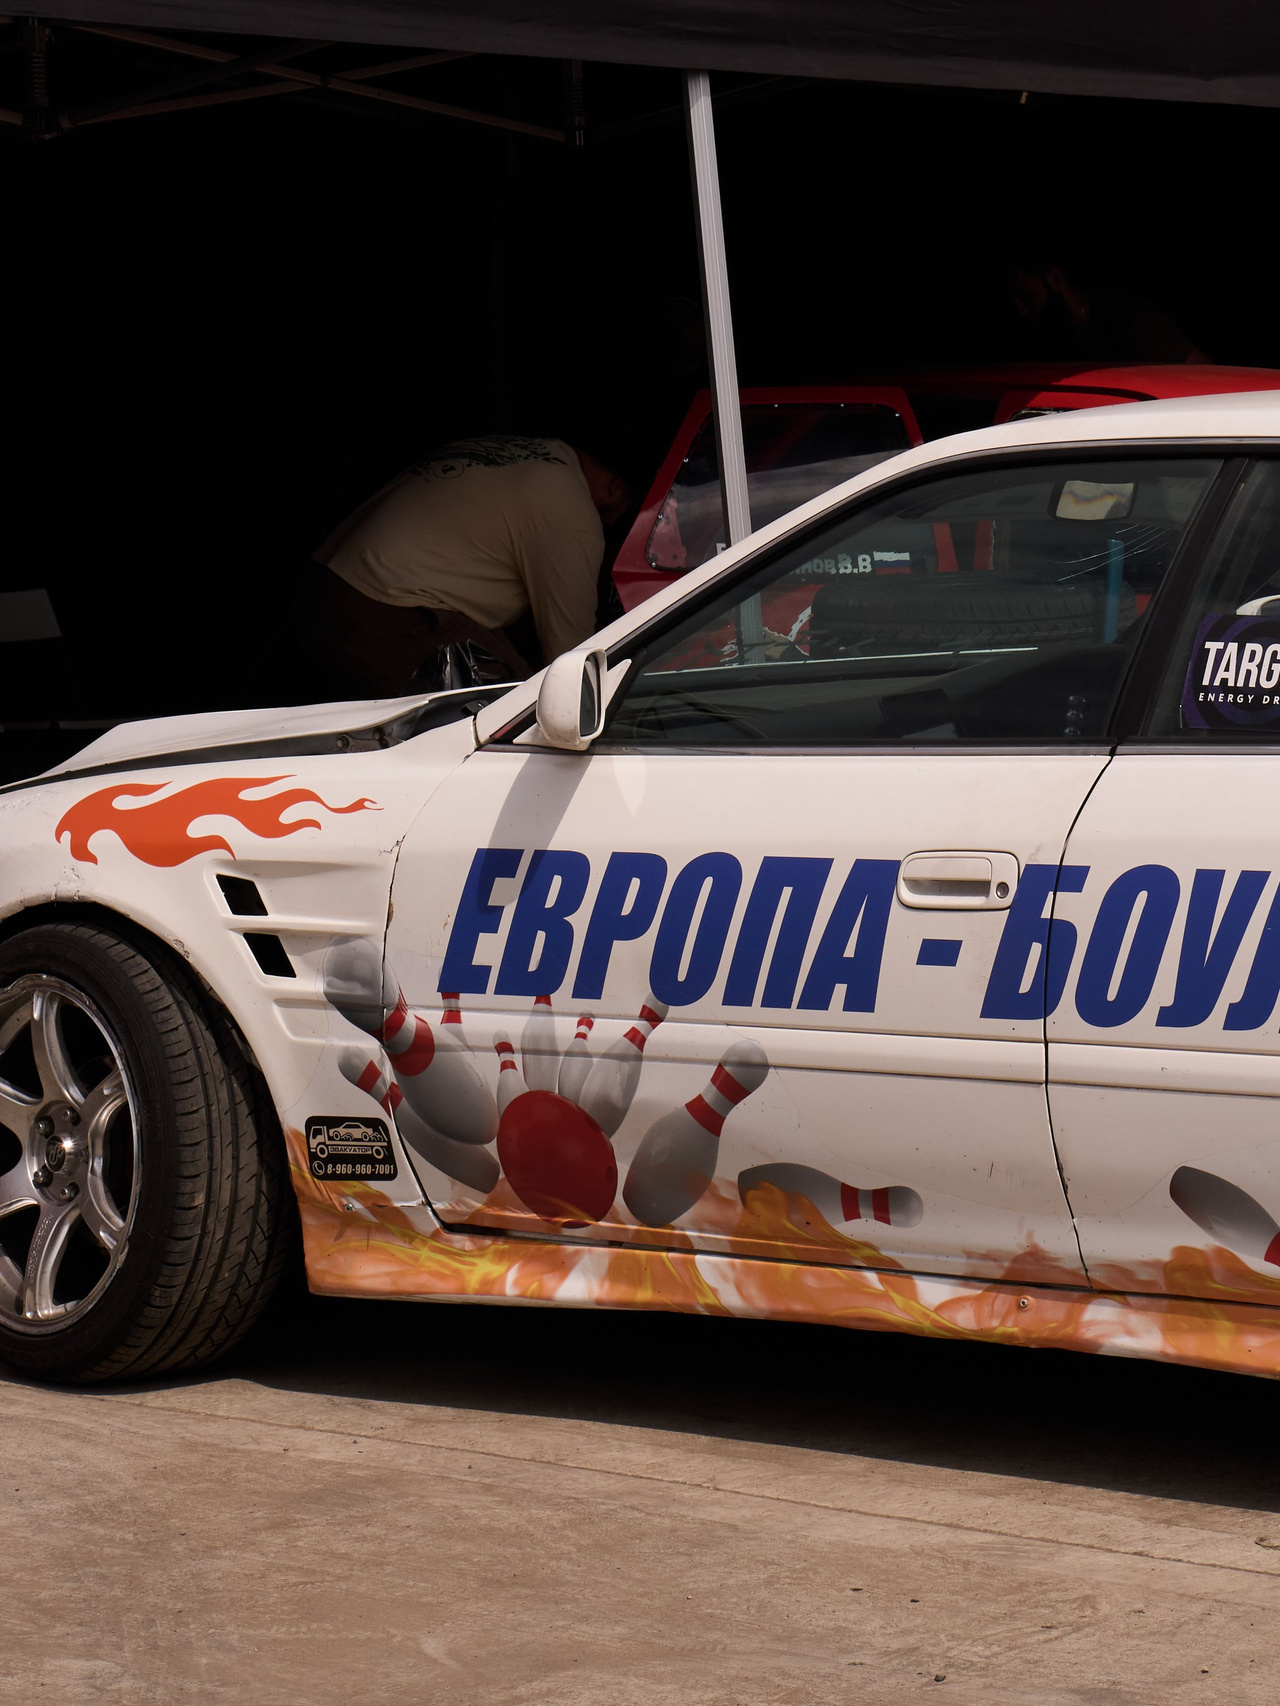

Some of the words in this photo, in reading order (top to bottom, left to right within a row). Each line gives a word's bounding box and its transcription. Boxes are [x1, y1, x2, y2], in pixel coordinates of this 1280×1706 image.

[1198, 692, 1255, 704] ENERGY
[437, 848, 901, 1013] ЕВРОПА
[327, 1164, 394, 1174] 8-960-960-7001
